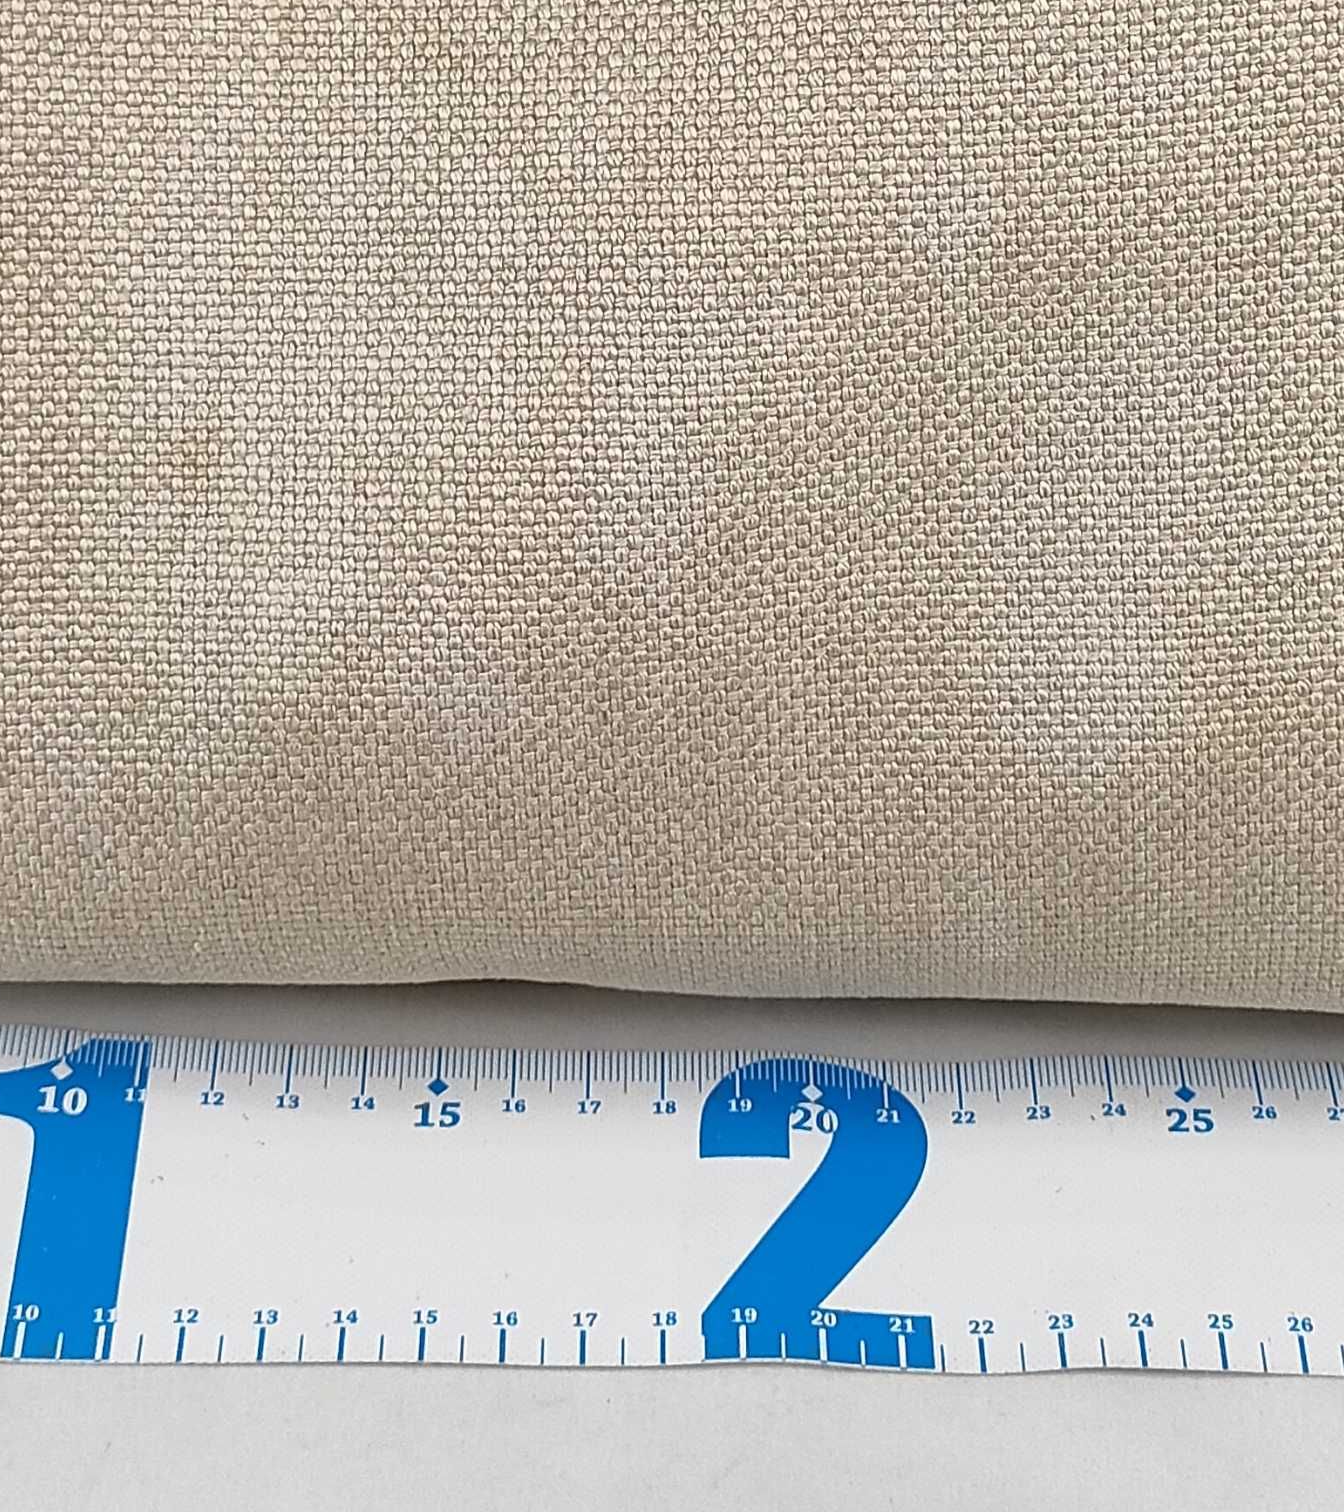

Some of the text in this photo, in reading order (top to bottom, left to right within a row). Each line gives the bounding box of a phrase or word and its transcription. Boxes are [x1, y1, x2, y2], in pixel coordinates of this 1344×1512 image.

[37, 1086, 88, 1116] 10
[124, 1088, 146, 1103] 11
[200, 1092, 225, 1106] 12
[276, 1095, 300, 1109] 13
[351, 1096, 375, 1111] 14
[413, 1102, 462, 1129] 15
[501, 1098, 527, 1113] 16
[577, 1099, 602, 1114] 17
[652, 1100, 677, 1115] 18
[727, 1098, 752, 1113] 19
[790, 1104, 839, 1135] 20
[876, 1109, 901, 1123] 21
[951, 1111, 976, 1124] 22
[1026, 1106, 1052, 1120] 23
[1102, 1103, 1127, 1117] 24
[1166, 1109, 1215, 1134] 25
[1252, 1106, 1277, 1120] 26
[699, 1058, 935, 1368] 2
[13, 1304, 40, 1321] 10
[93, 1307, 118, 1323] 11
[173, 1309, 199, 1323] 12
[253, 1310, 279, 1324] 13
[333, 1310, 358, 1324] 14
[413, 1309, 438, 1324] 15
[492, 1311, 518, 1326] 16
[573, 1312, 598, 1327] 17
[652, 1311, 678, 1326] 18
[732, 1307, 757, 1323] 19
[811, 1311, 837, 1328] 20
[890, 1317, 915, 1333] 21
[969, 1320, 994, 1334] 22
[1048, 1314, 1074, 1330] 23
[1128, 1313, 1154, 1328] 24
[1208, 1314, 1234, 1330] 25
[1288, 1316, 1314, 1332] 26
